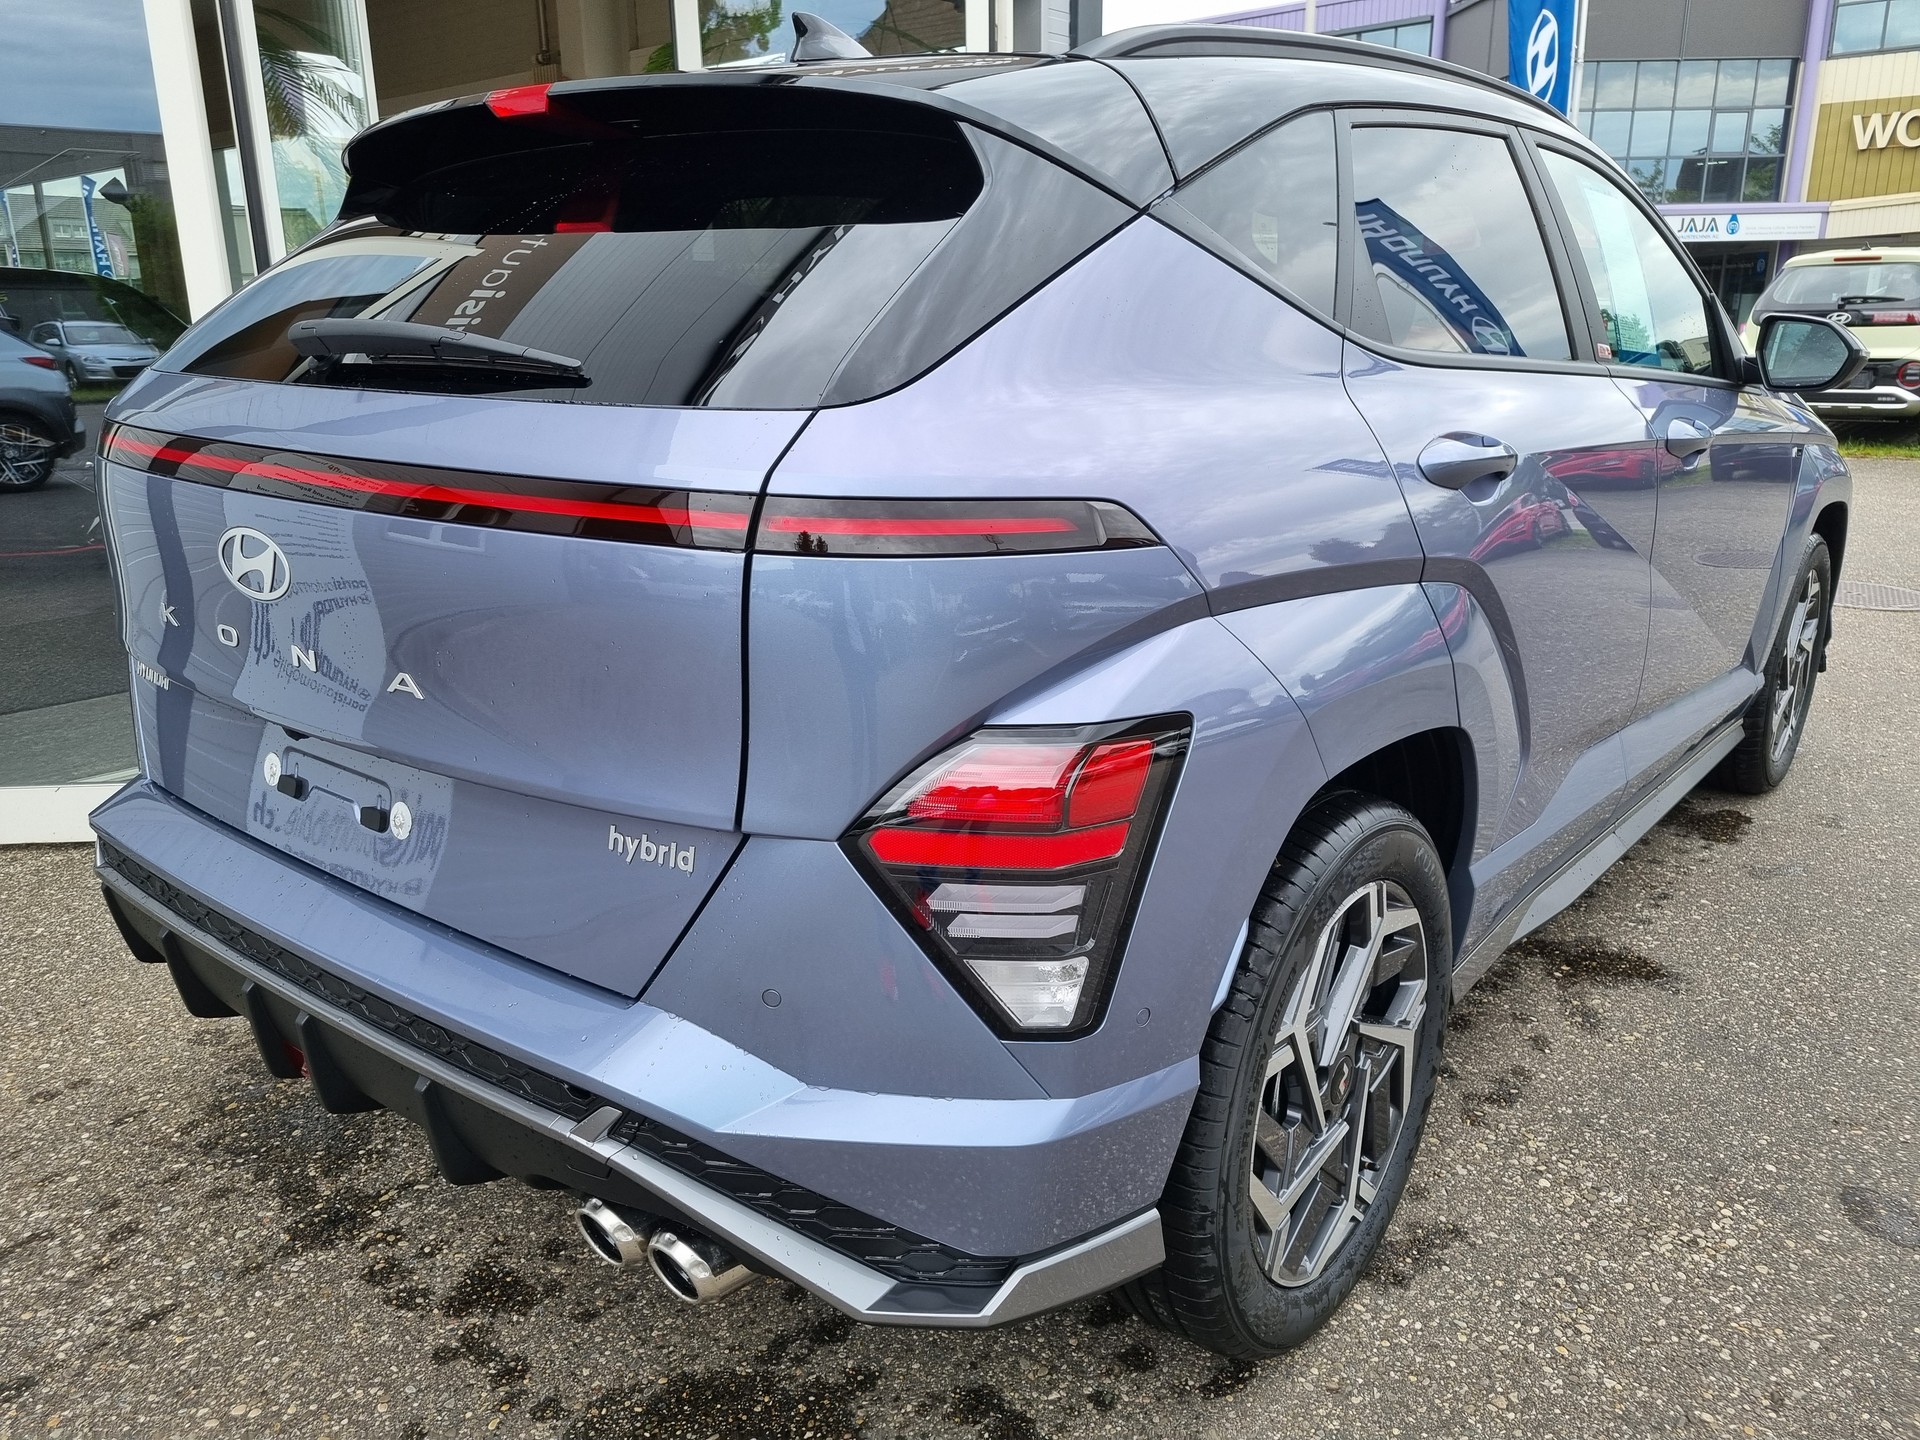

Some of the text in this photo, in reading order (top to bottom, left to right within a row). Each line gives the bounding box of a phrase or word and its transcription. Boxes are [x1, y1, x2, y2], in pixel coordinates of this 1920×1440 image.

[1677, 217, 1719, 233] JAJA
[161, 602, 425, 700] KONA
[137, 660, 171, 691] HYUNDAI
[608, 823, 696, 873] hybrid
